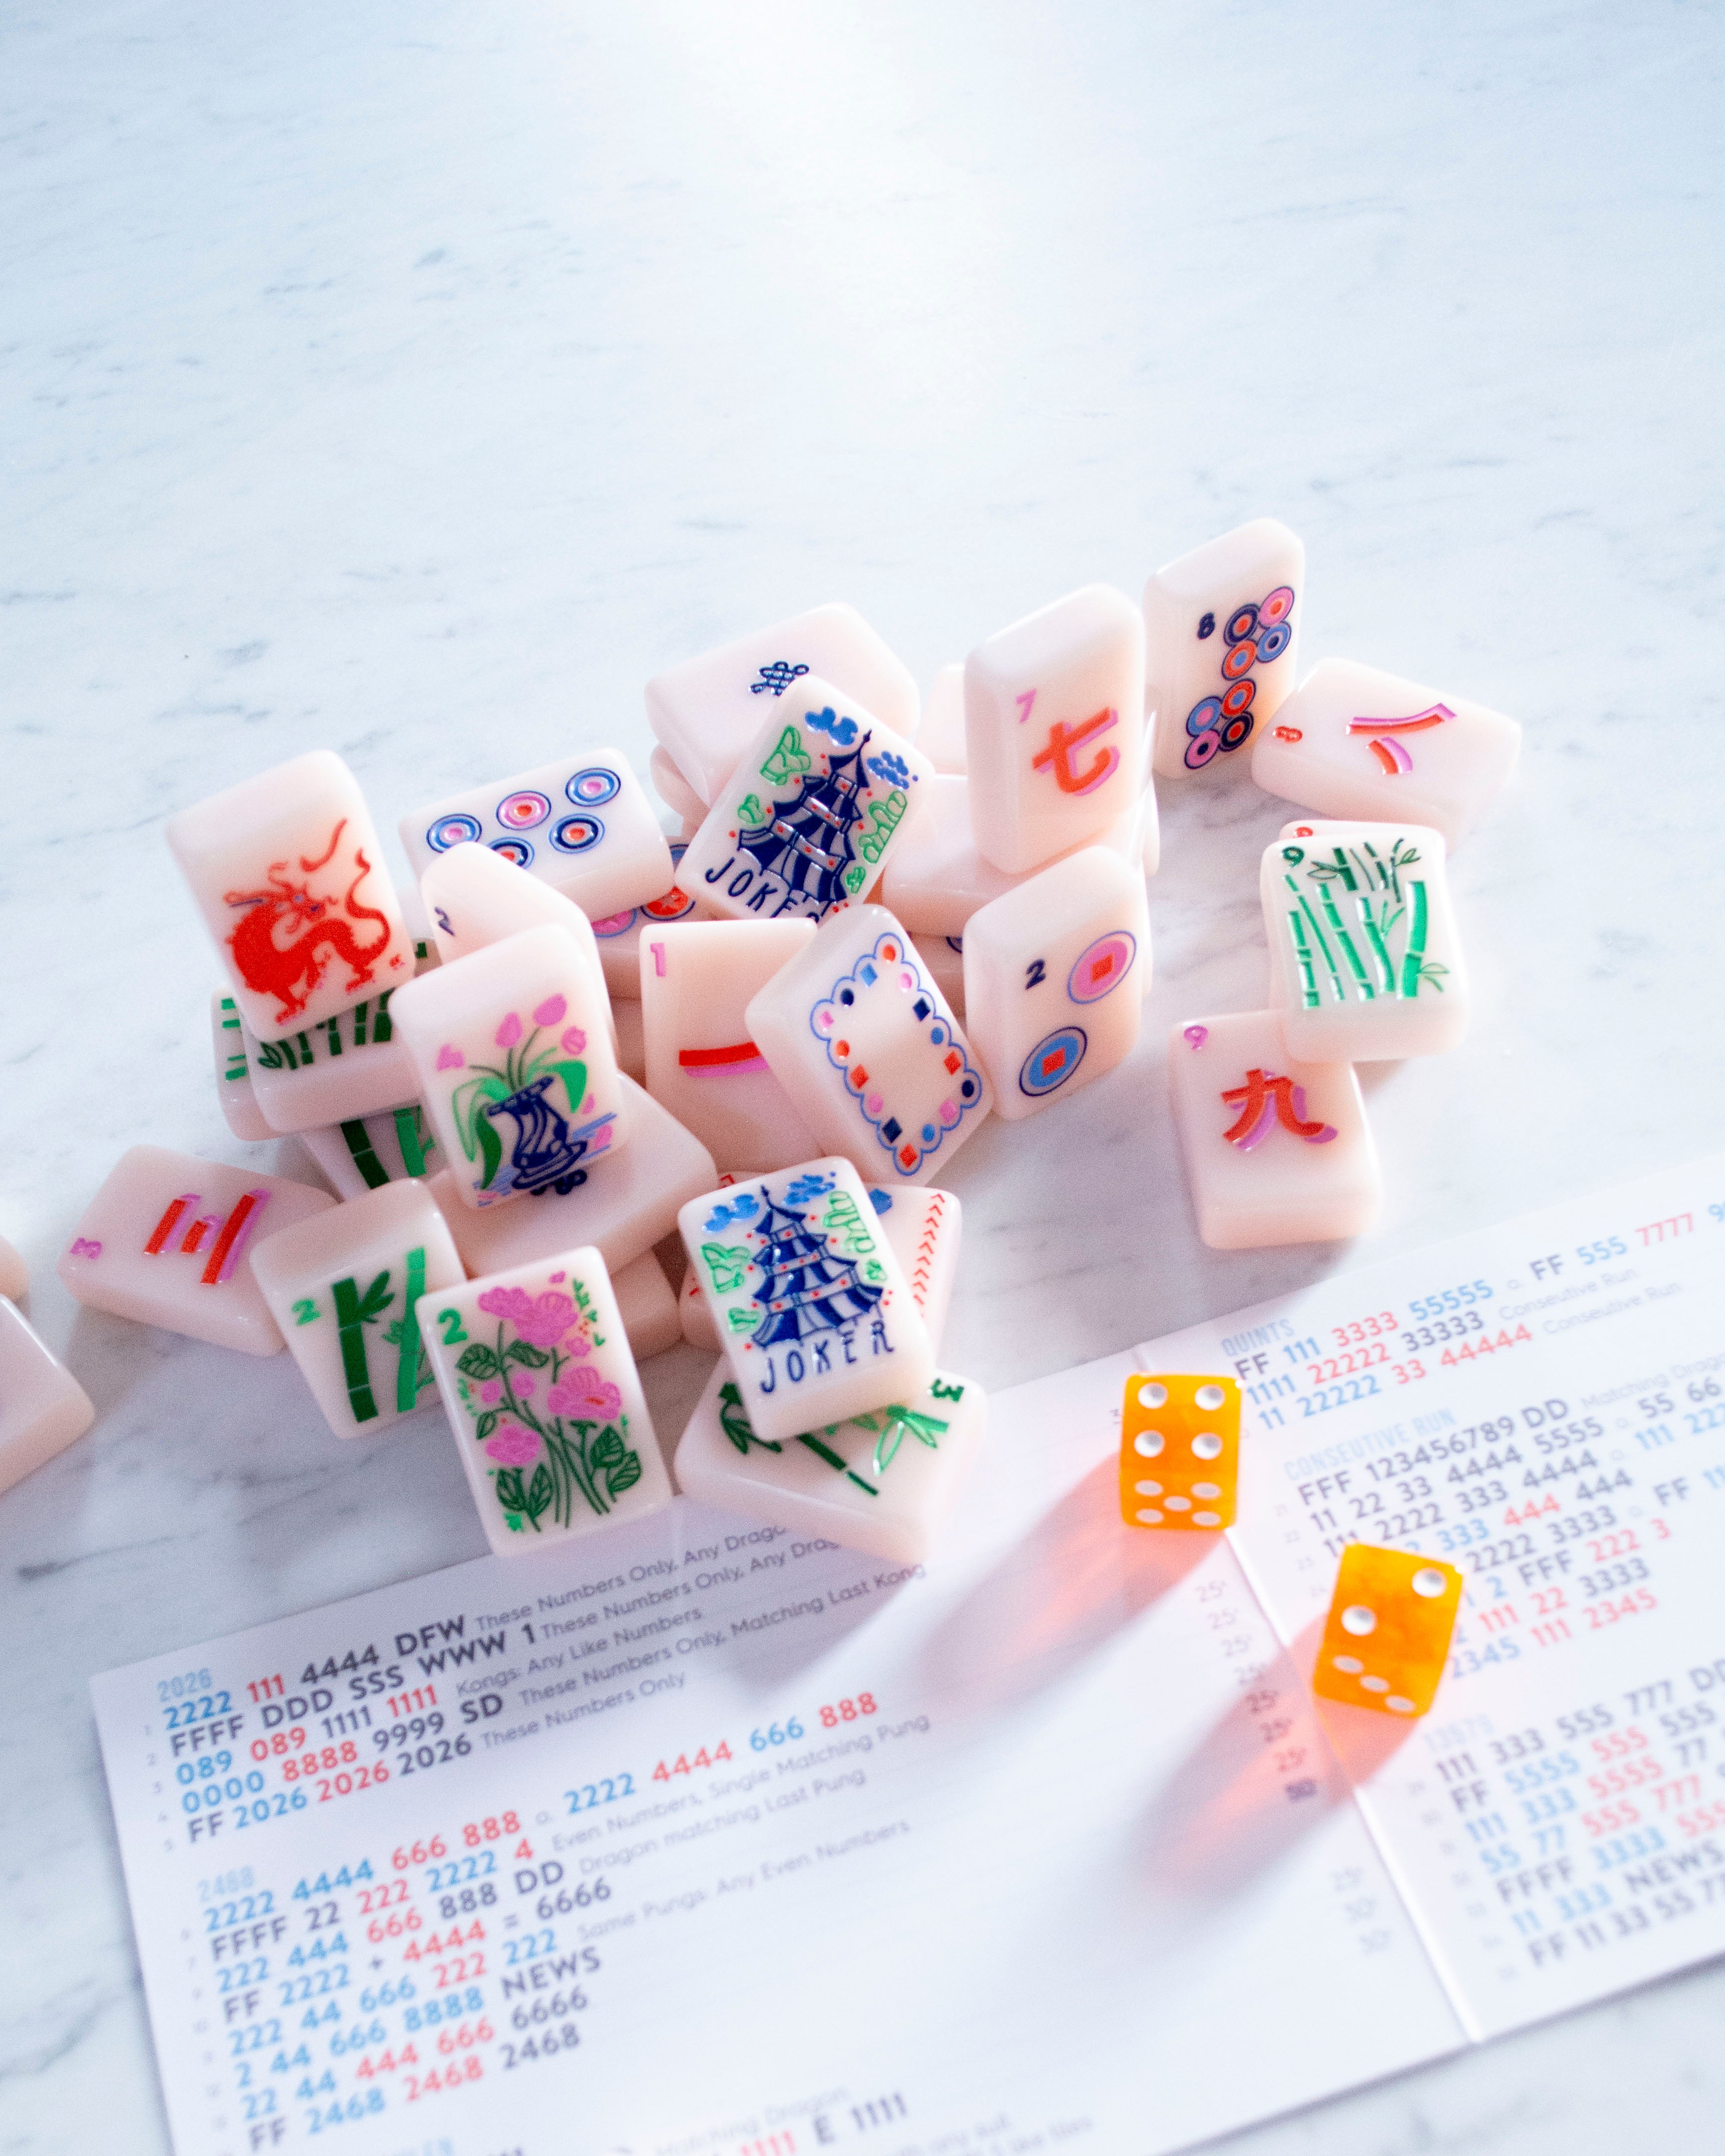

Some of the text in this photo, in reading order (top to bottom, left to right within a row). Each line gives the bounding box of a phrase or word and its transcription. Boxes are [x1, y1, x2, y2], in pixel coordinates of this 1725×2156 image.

[1197, 613, 1215, 640] 8
[1017, 689, 1036, 723] 7
[1032, 707, 1120, 797] 七
[1282, 846, 1304, 868] 9
[649, 943, 667, 977] 1
[1025, 958, 1046, 989] 2
[1184, 1025, 1208, 1050] 9
[1220, 1068, 1338, 1151] 九
[291, 1299, 321, 1325] 2
[437, 1307, 468, 1345] 2
[1221, 1318, 1296, 1357] QUINTS
[1235, 1213, 1694, 1381] FF 111 3333 55555 FF 555 7777
[761, 1320, 895, 1394] JOKER
[929, 1378, 964, 1402] 3
[1246, 1374, 1296, 1405] 1111
[1307, 1342, 1391, 1385] 22222
[1401, 1311, 1484, 1352] 33333
[1296, 1374, 1382, 1417] 22222
[1391, 1359, 1427, 1384] 33
[1440, 1323, 1533, 1368] 44444
[1297, 1399, 1569, 1506] FFF 123456789 DD
[1310, 1377, 1722, 1533] 11 22 33 4444 5555 55 66
[1375, 1449, 1599, 1542] 2222 333 4444
[1436, 1468, 1634, 1553] 333 444 444
[163, 1692, 232, 1730] 2222
[247, 1674, 286, 1702] 111
[300, 1645, 379, 1684] 4444
[394, 1615, 465, 1657] DFW
[476, 1603, 533, 1635] These
[538, 1575, 625, 1613] Numbers
[684, 1543, 720, 1567] Any
[170, 1715, 244, 1757] FFFF
[261, 1688, 333, 1729] DDD
[349, 1666, 404, 1702] SSS
[418, 1631, 507, 1676] WWW
[522, 1624, 535, 1645] 1
[540, 1612, 598, 1641] These
[603, 1581, 691, 1621] Numbers
[750, 1550, 786, 1574] Any
[176, 1751, 233, 1785] 089
[250, 1727, 306, 1762] 089
[321, 1705, 372, 1738] 1111
[386, 1684, 438, 1717] 1111
[527, 1654, 565, 1677] Any
[570, 1635, 608, 1659] Like
[181, 1770, 265, 1814] 0000
[282, 1741, 359, 1782] 8888
[373, 1712, 445, 1752] 9999
[462, 1694, 503, 1724] SD
[519, 1674, 578, 1705] These
[582, 1645, 672, 1685] Numbers
[730, 1593, 824, 1637] Matching
[828, 1578, 871, 1607] Last
[188, 1671, 685, 1842] FF 2026 2026 2026 These Numbers Only
[204, 1691, 878, 1932] 2222 4444 666 888 2222 4444 666 888
[211, 1916, 288, 1962] FFFF
[306, 1901, 341, 1932] 22
[357, 1879, 411, 1915] 222
[425, 1850, 498, 1893] 2222
[514, 1839, 534, 1860] 4
[216, 1957, 270, 1993] 222
[287, 1931, 349, 1967] 444
[367, 1908, 424, 1944] 666
[440, 1882, 499, 1919] 888
[514, 1860, 564, 1895] DD
[223, 1877, 612, 2023] FF 2222 4444 6666
[229, 1929, 558, 2056] 222 44 666 222 222
[236, 2062, 252, 2088] 2
[270, 2044, 311, 2074] 44
[329, 2020, 387, 2057] 666
[501, 1947, 602, 1999] NEWS
[241, 1986, 589, 2120] 22 44 444 666 6666
[248, 2023, 582, 2152] FF 2468 2468 2468
